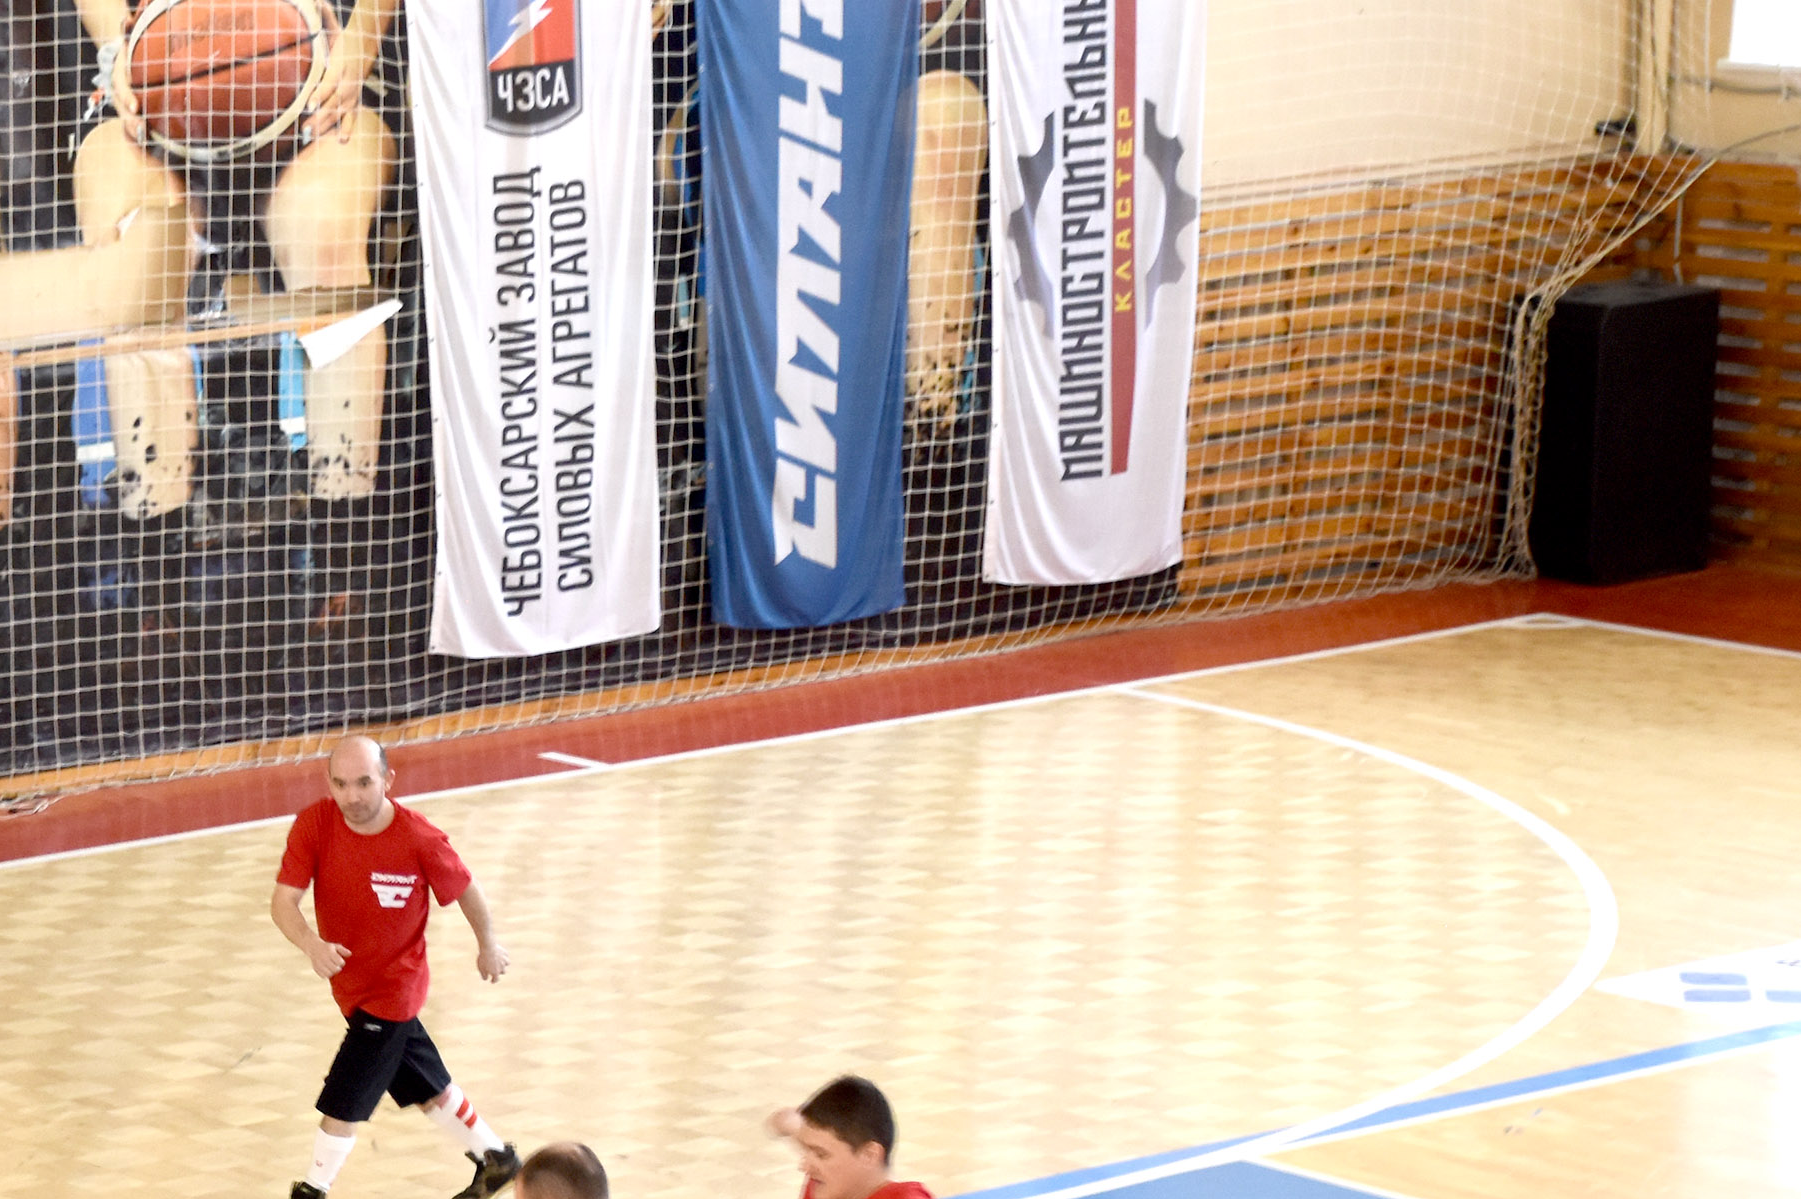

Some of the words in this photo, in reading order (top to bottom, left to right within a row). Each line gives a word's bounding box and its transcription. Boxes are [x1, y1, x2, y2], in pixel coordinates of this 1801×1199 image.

[497, 66, 570, 113] ЧЗСА
[493, 166, 541, 306] ЗАВОД
[549, 179, 594, 389] АГРЕГАТОВ
[1114, 107, 1133, 312] КЛАСТЕР
[489, 317, 542, 617] ЧЕБОКСАРСКИЙ
[552, 403, 595, 592] СИЛОВЫХ
